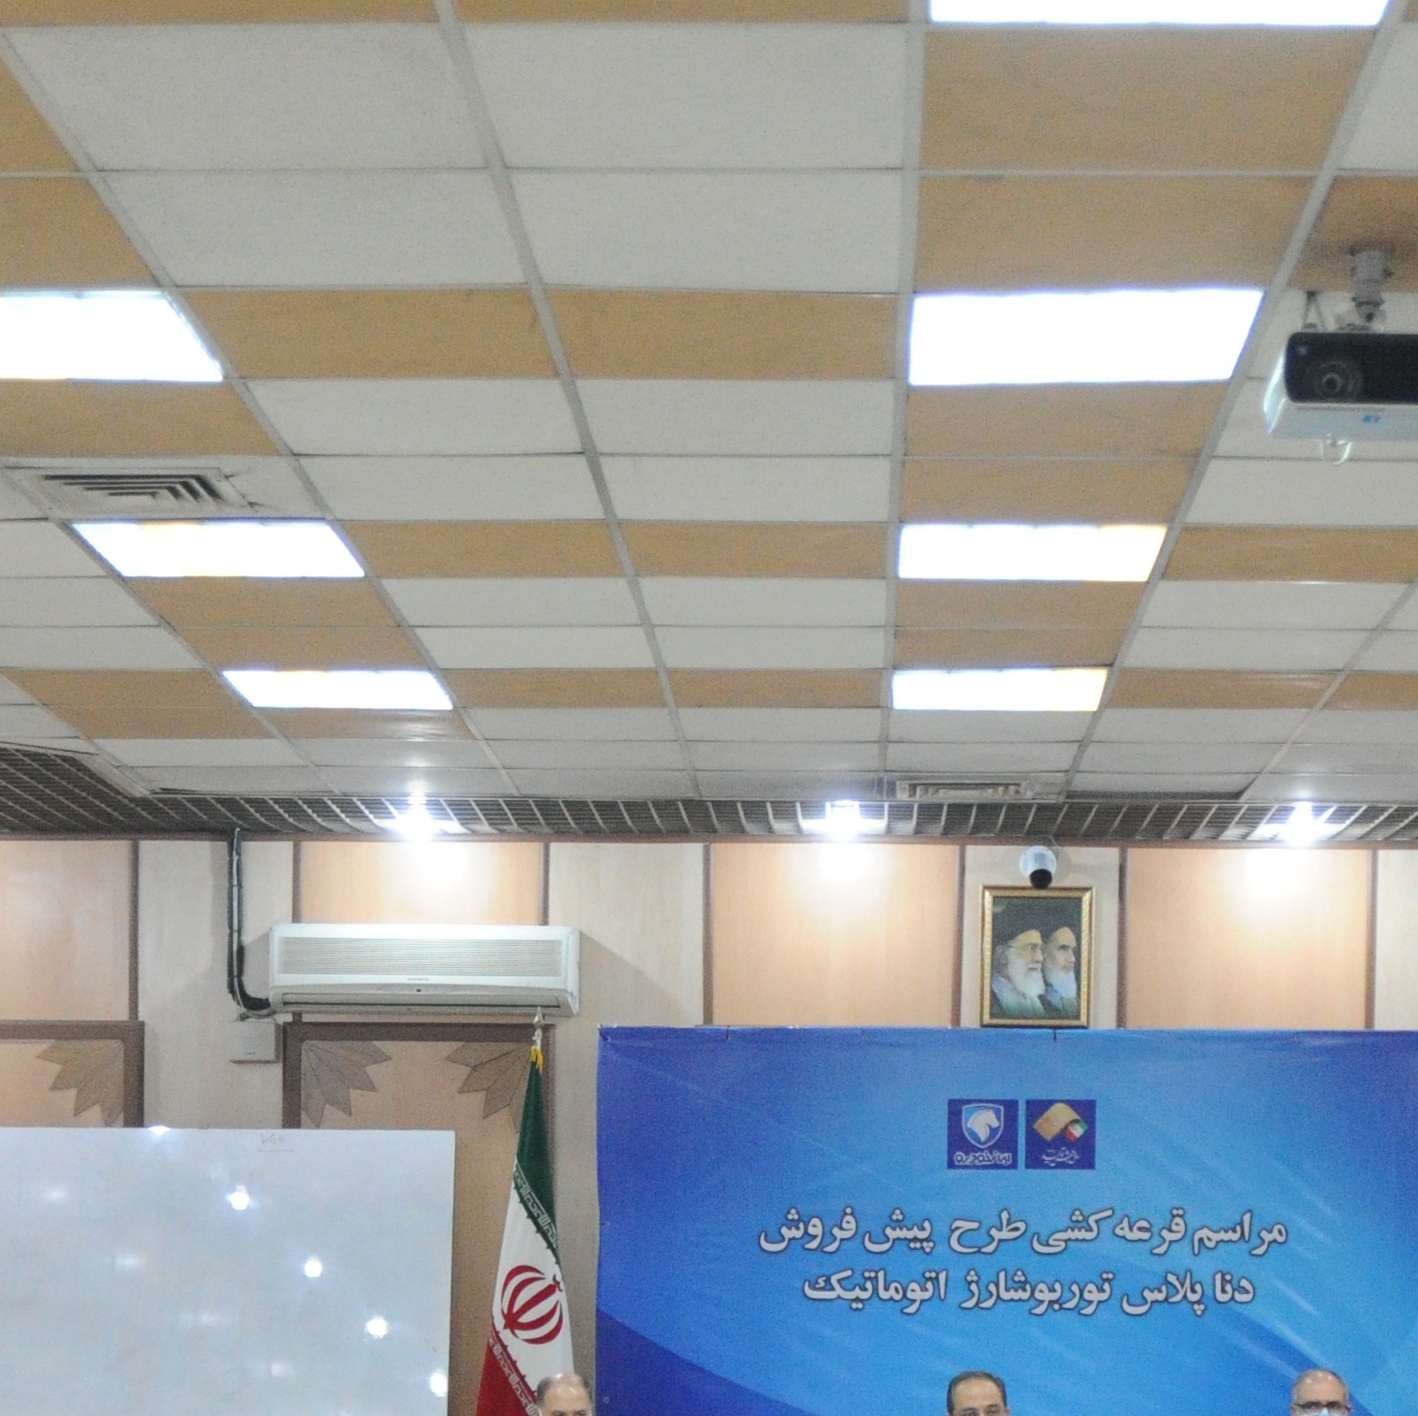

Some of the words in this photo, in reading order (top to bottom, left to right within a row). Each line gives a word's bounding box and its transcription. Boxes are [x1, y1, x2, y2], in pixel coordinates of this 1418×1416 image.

[759, 1206, 857, 1254] فروش
[863, 1207, 935, 1254] پیش
[949, 1208, 1028, 1255] طرح
[1032, 1207, 1114, 1255] کشی
[1113, 1207, 1187, 1256] قرعه
[1192, 1209, 1288, 1256] مراسم
[959, 1268, 1114, 1316] توربوشارژ
[1121, 1269, 1206, 1316] پلاس
[1214, 1270, 1255, 1303] دنا
